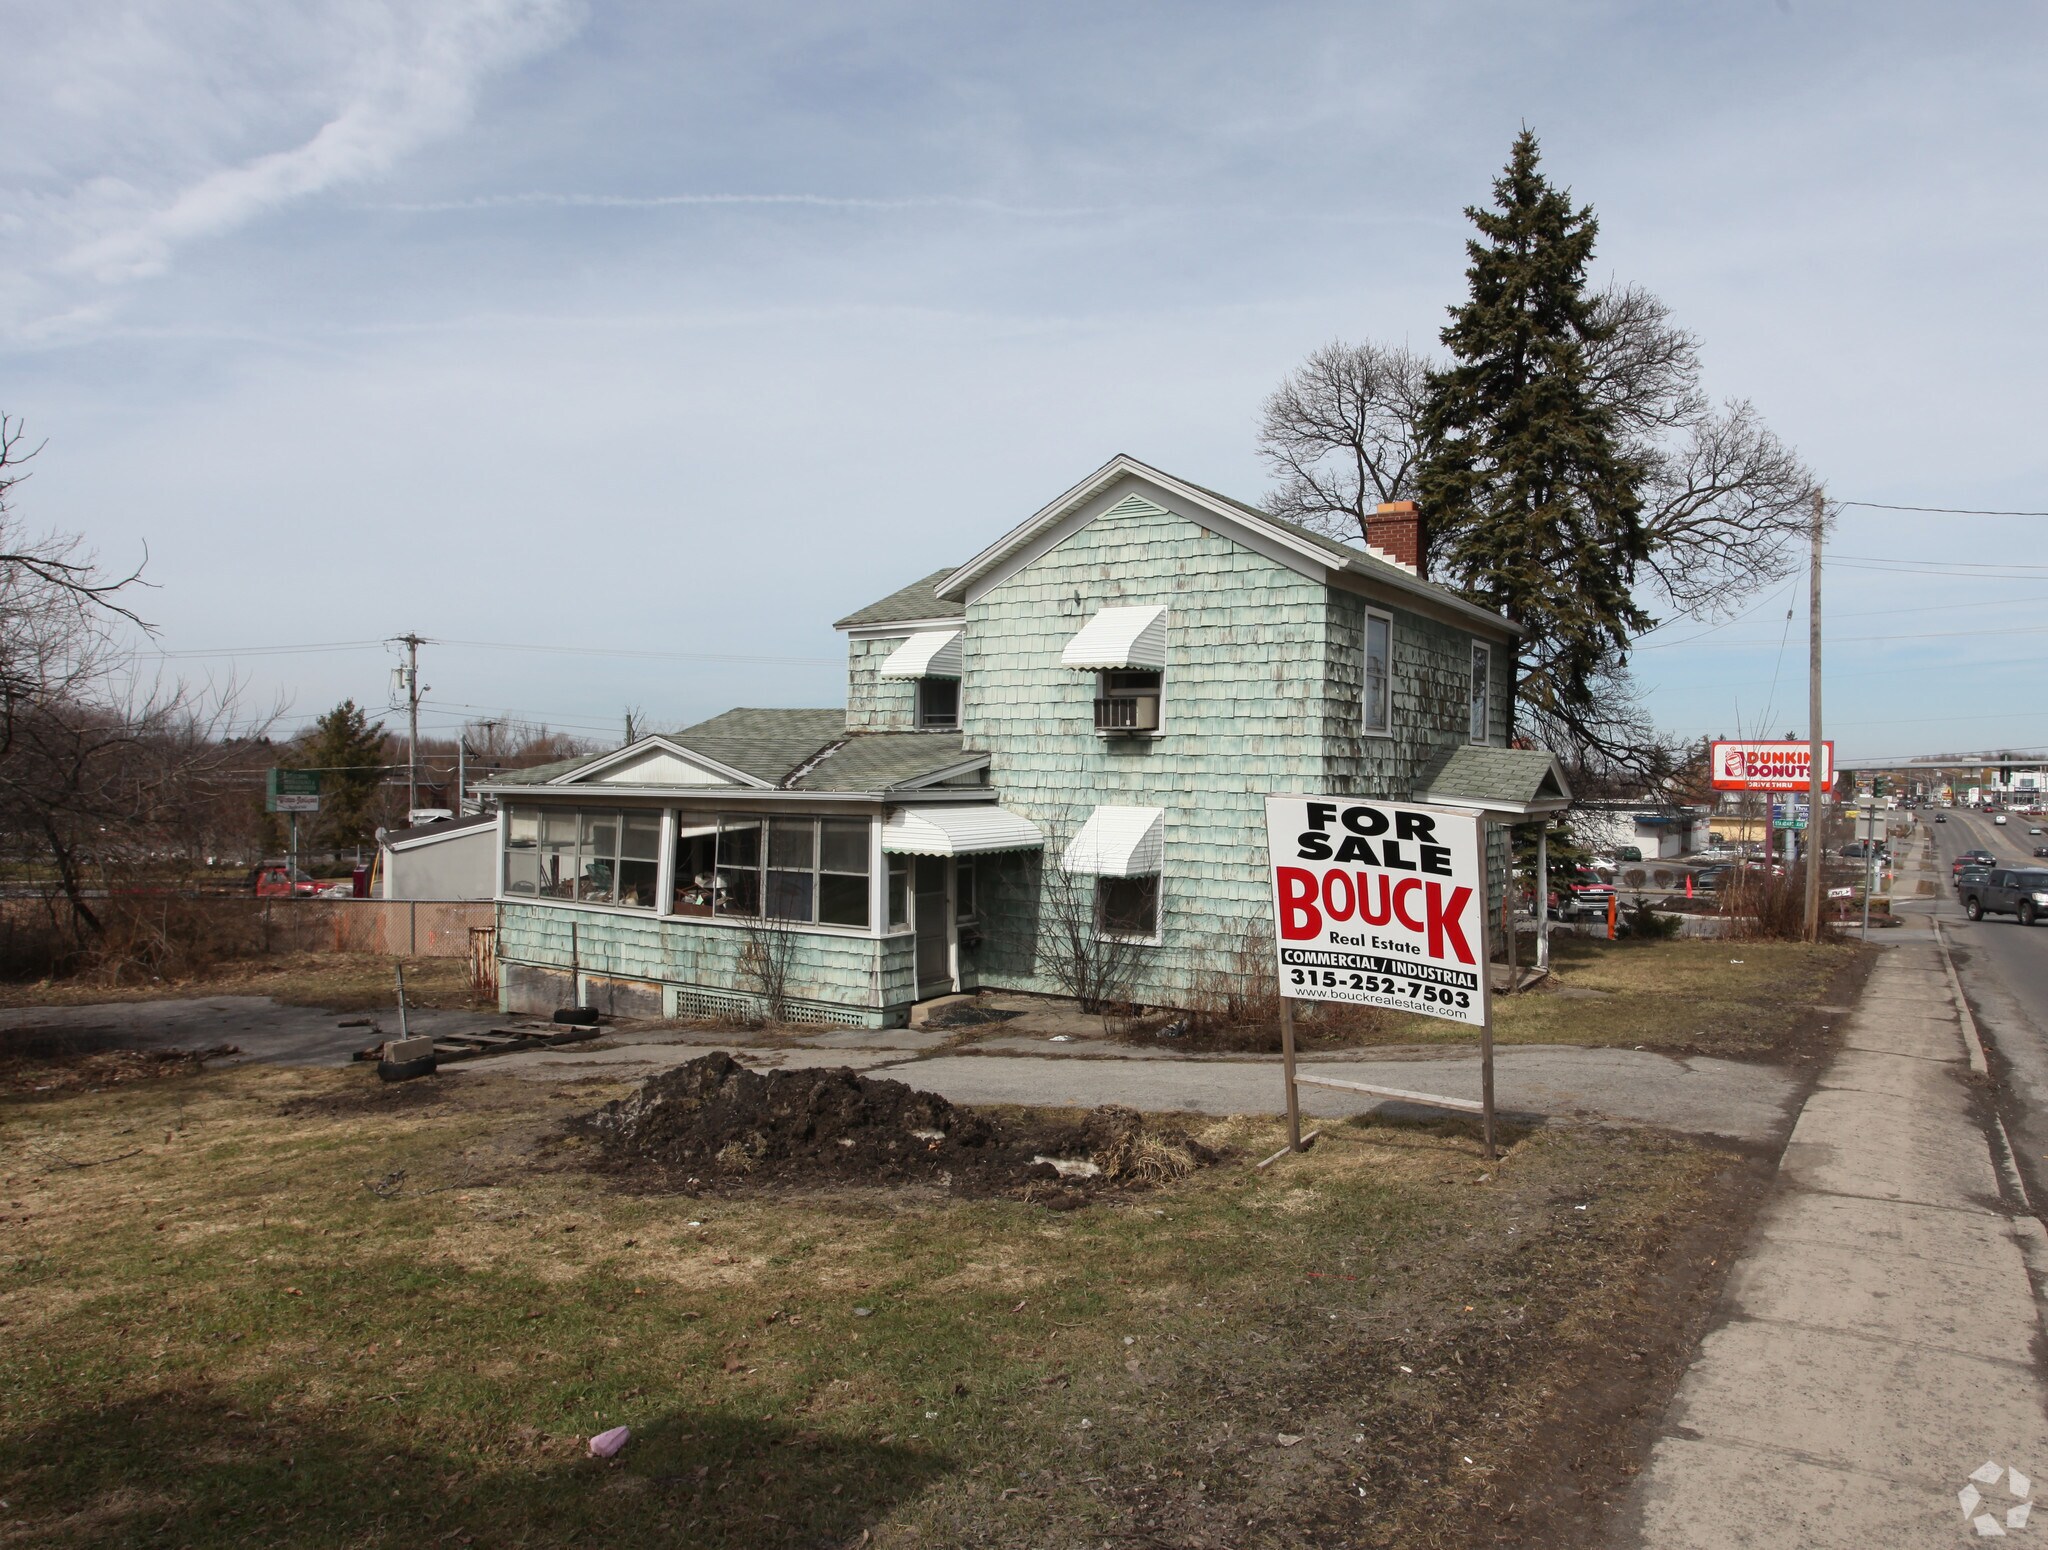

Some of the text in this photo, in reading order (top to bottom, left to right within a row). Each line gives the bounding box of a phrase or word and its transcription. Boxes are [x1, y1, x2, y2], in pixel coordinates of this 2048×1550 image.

[1306, 802, 1439, 844] FOR
[1297, 832, 1453, 877] SALE
[1276, 866, 1476, 965] BOUCK
[1330, 931, 1421, 955] Real Estate
[1284, 950, 1475, 988] COMMERCIAL / INDUSTRIAL
[1290, 968, 1470, 1009] 315-252-7503
[1295, 987, 1467, 1019] www.bouckrealestate.com
